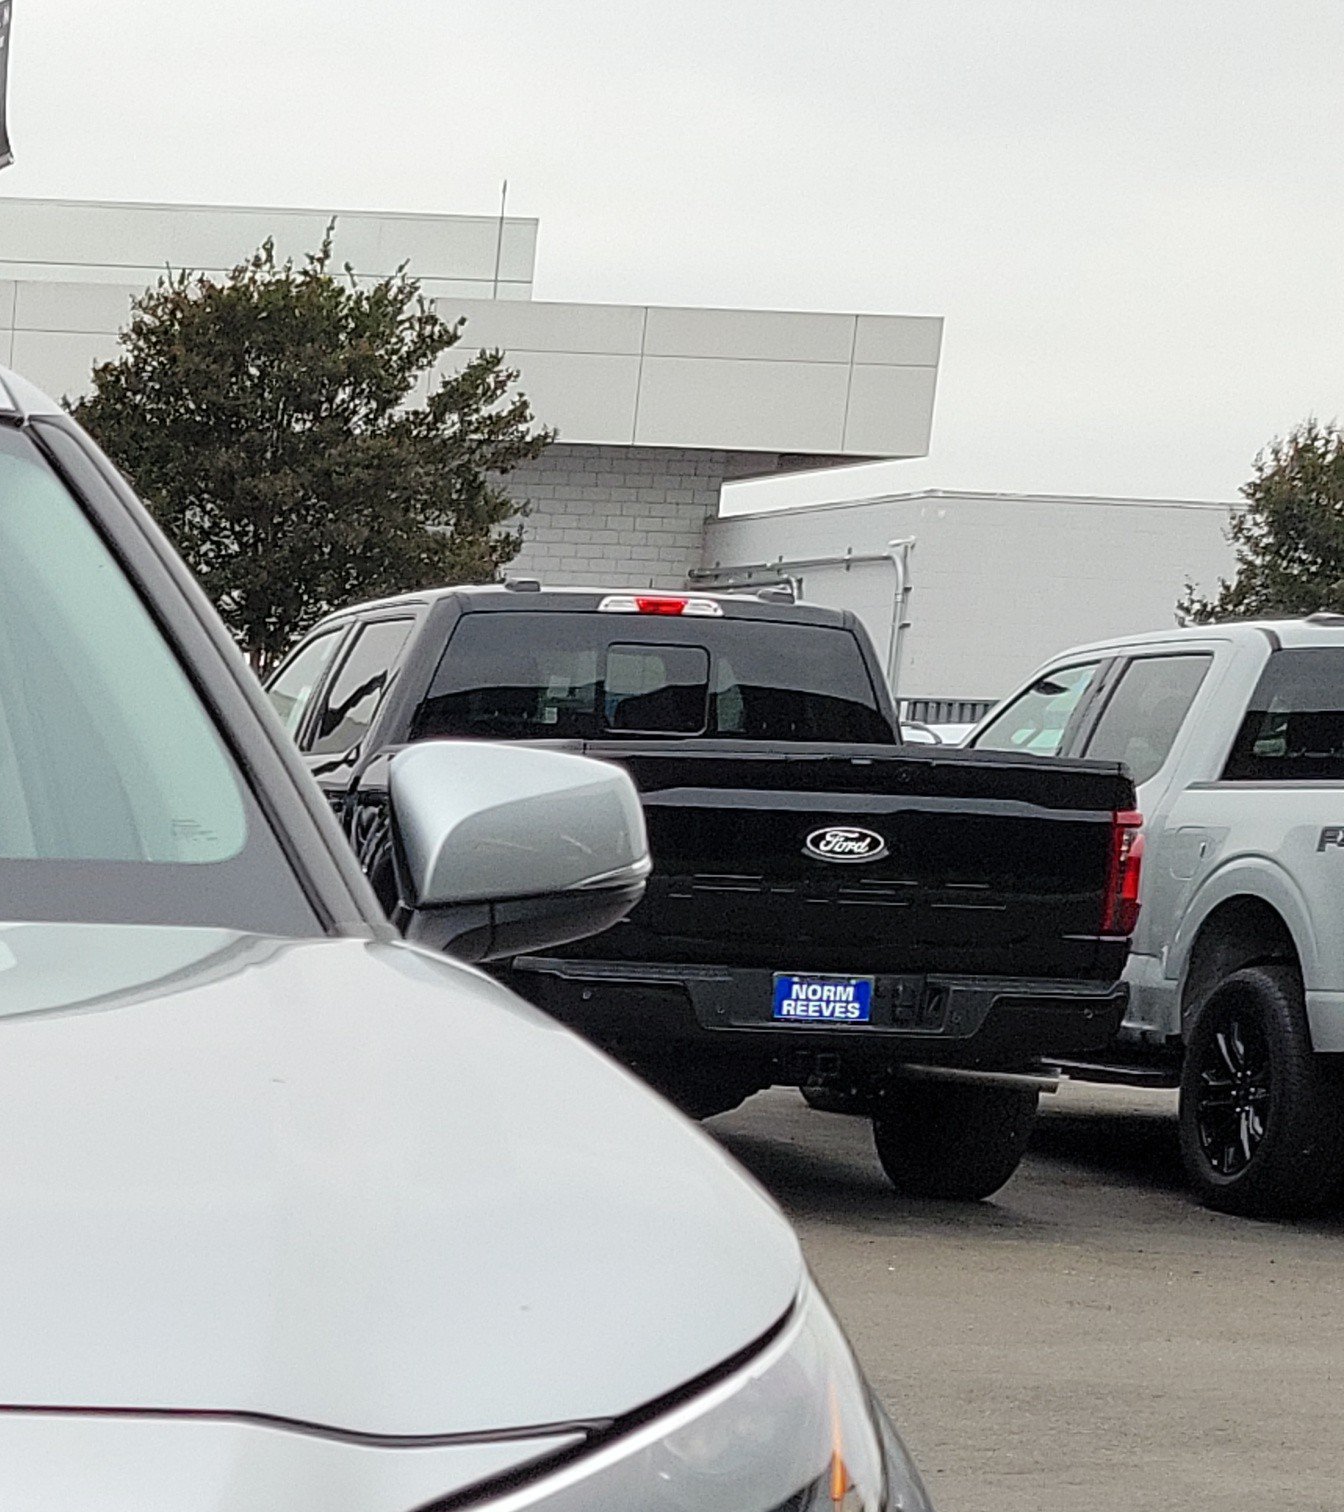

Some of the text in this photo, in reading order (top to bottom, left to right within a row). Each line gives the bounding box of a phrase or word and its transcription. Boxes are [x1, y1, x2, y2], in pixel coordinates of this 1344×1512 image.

[819, 830, 872, 854] Ford
[791, 984, 855, 1001] NORM
[781, 1000, 861, 1018] REEVES
